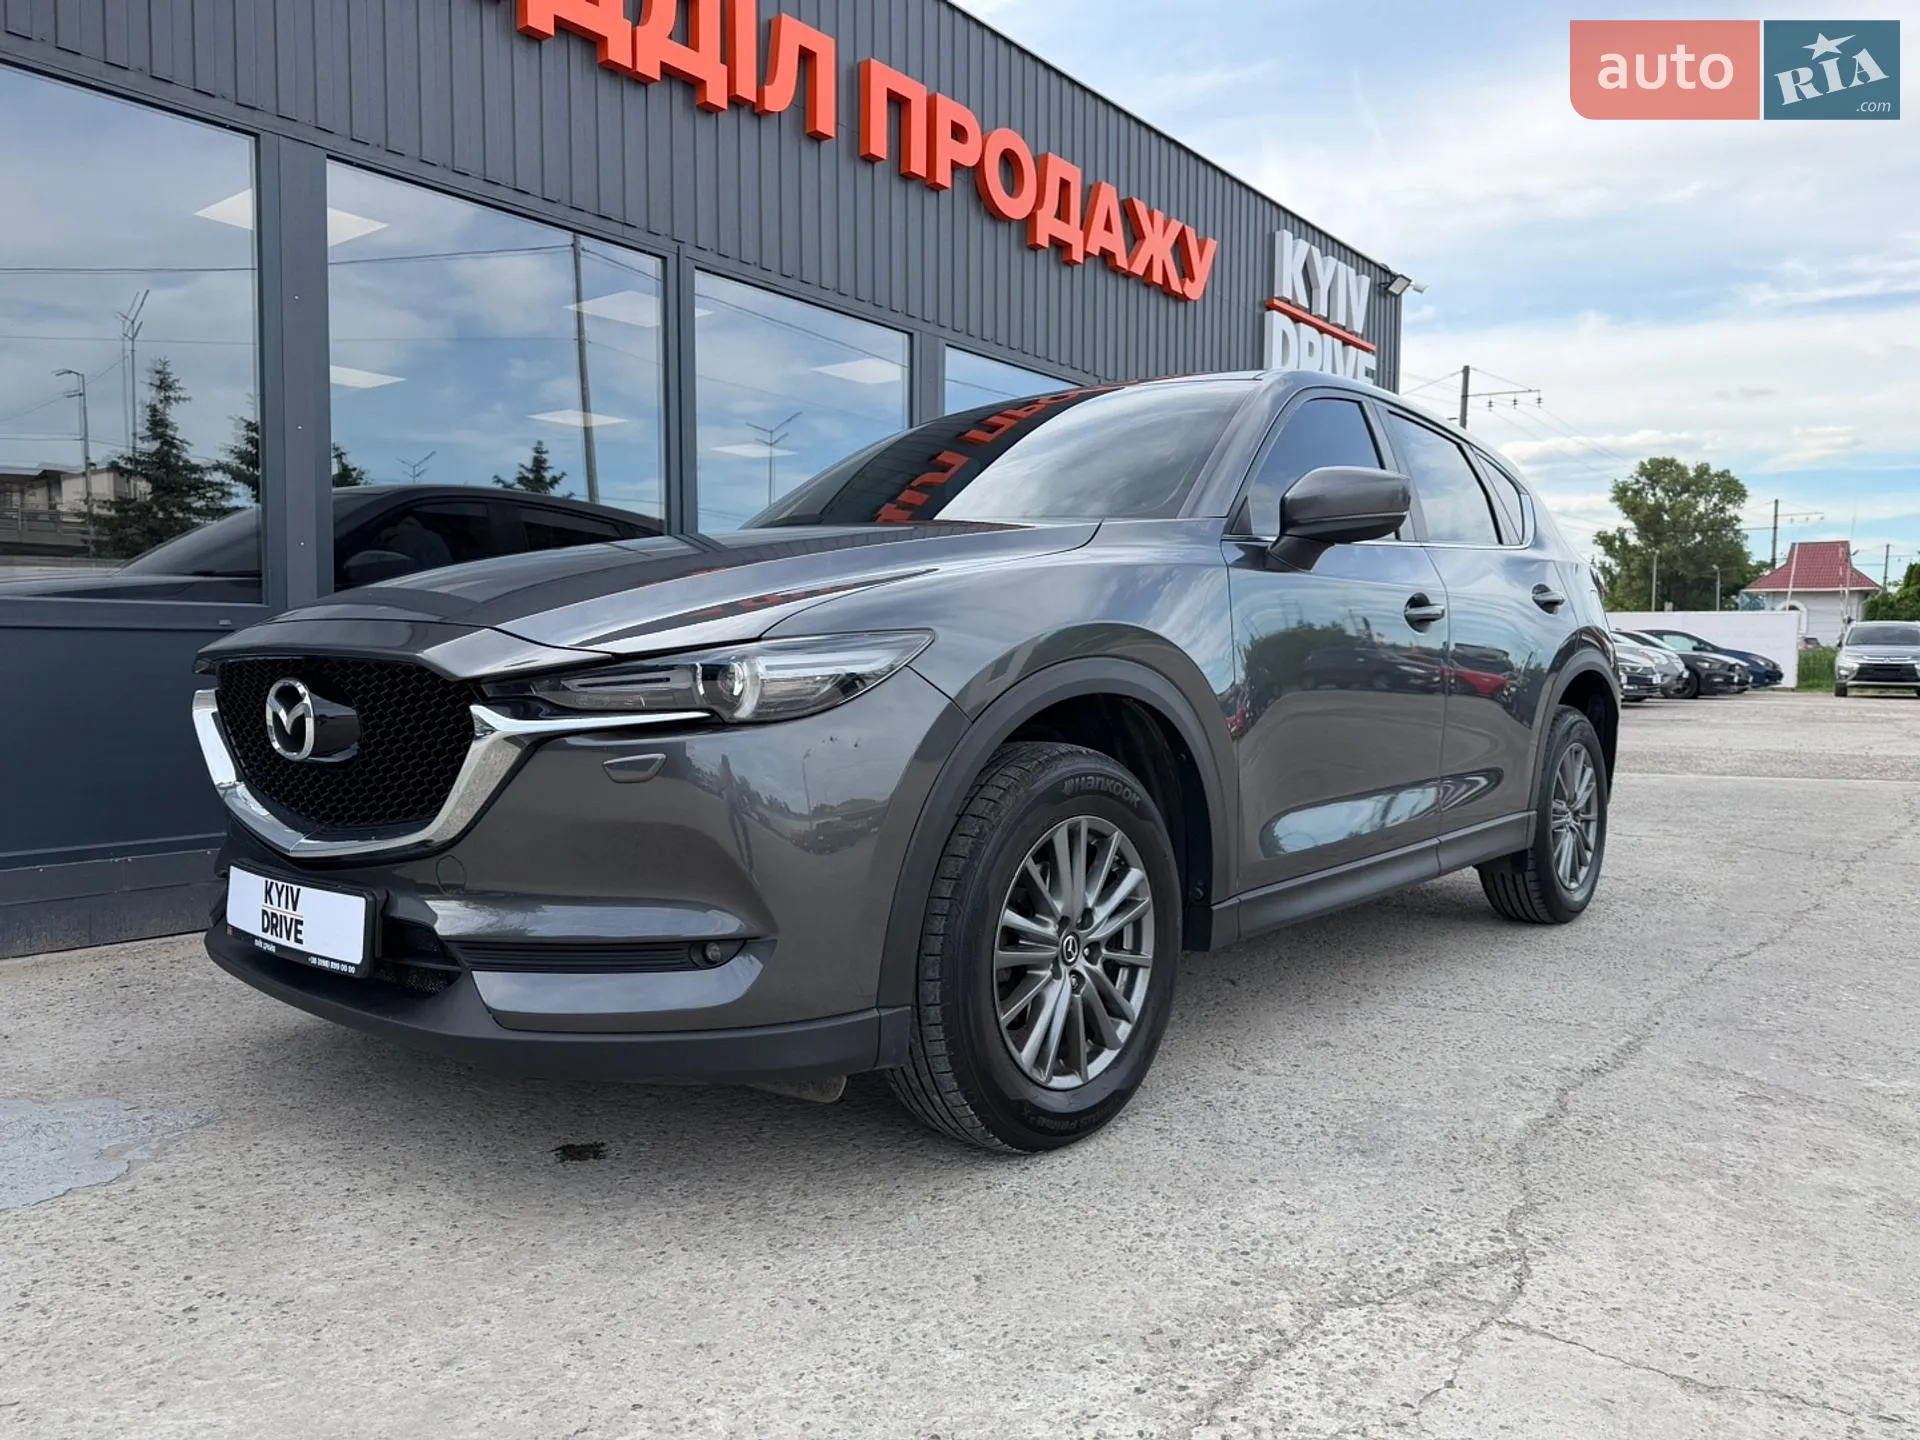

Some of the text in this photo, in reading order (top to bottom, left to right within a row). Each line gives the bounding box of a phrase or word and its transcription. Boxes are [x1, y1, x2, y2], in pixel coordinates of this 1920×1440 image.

[858, 57, 1217, 301] ПРОДАЖУ
[1274, 228, 1371, 335] KYIV
[261, 909, 304, 945] DRIVE
[264, 880, 302, 912] KYIV
